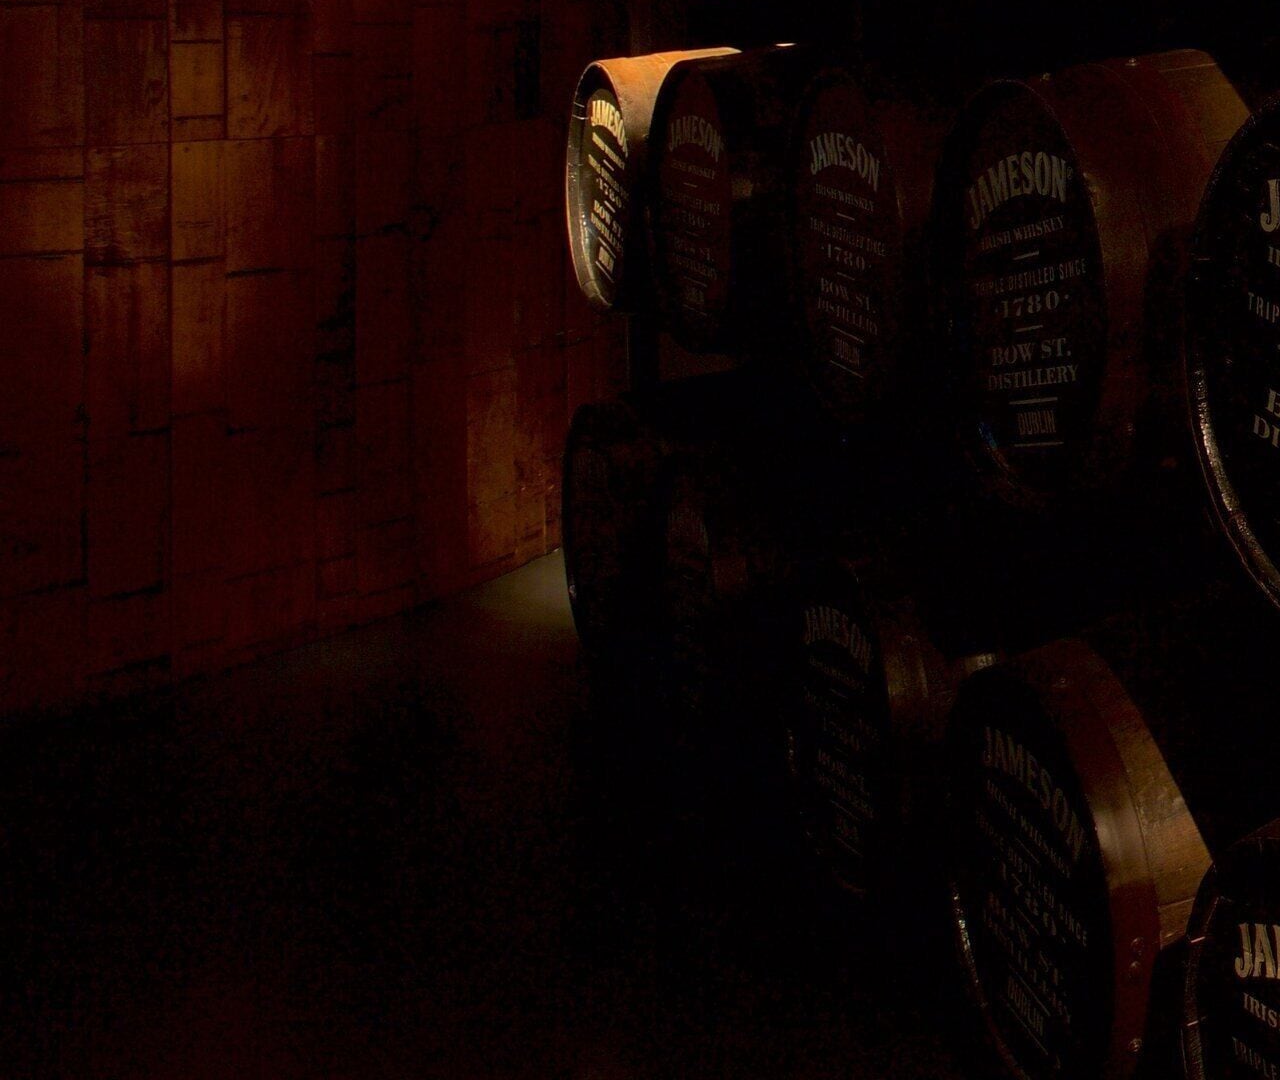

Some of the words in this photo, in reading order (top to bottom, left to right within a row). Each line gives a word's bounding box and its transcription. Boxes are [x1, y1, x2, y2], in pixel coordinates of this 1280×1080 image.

[810, 131, 880, 193] JAMESON
[992, 341, 1033, 367] BOW
[1040, 337, 1072, 361] ST.
[987, 365, 1080, 393] DISTILLERY
